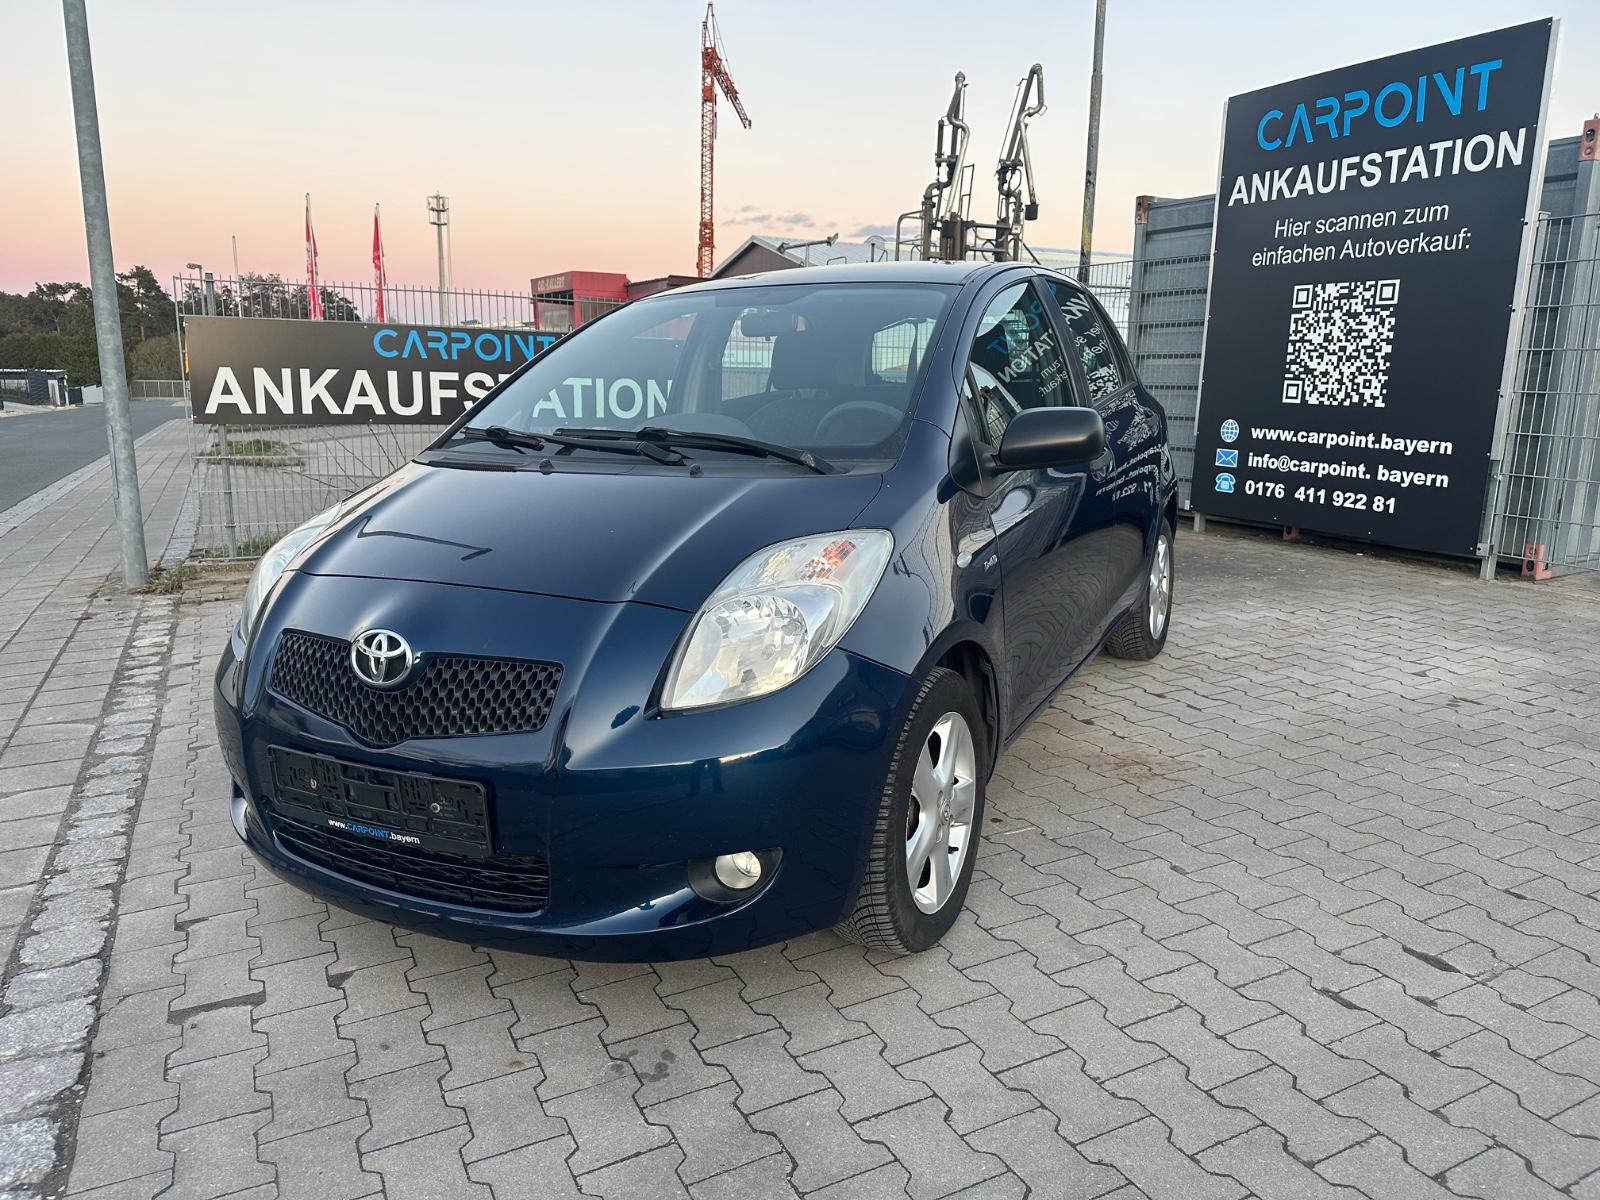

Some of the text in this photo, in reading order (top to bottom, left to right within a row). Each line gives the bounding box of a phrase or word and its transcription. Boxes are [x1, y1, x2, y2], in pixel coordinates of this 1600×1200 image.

[1257, 59, 1503, 152] CARPOINT
[1228, 127, 1527, 207] ANKAUFSTATION
[1274, 203, 1450, 239] Hier scannen zum
[1252, 227, 1472, 267] einfachen Autoverkauf:
[373, 328, 556, 362] CARPOINT
[1250, 427, 1453, 456] www.carpoint.bayern
[1247, 452, 1450, 488] info@carpoint. bayern
[1244, 480, 1396, 514] 0176 411 922 81
[327, 819, 420, 845] www.CARPOINT.bayern
